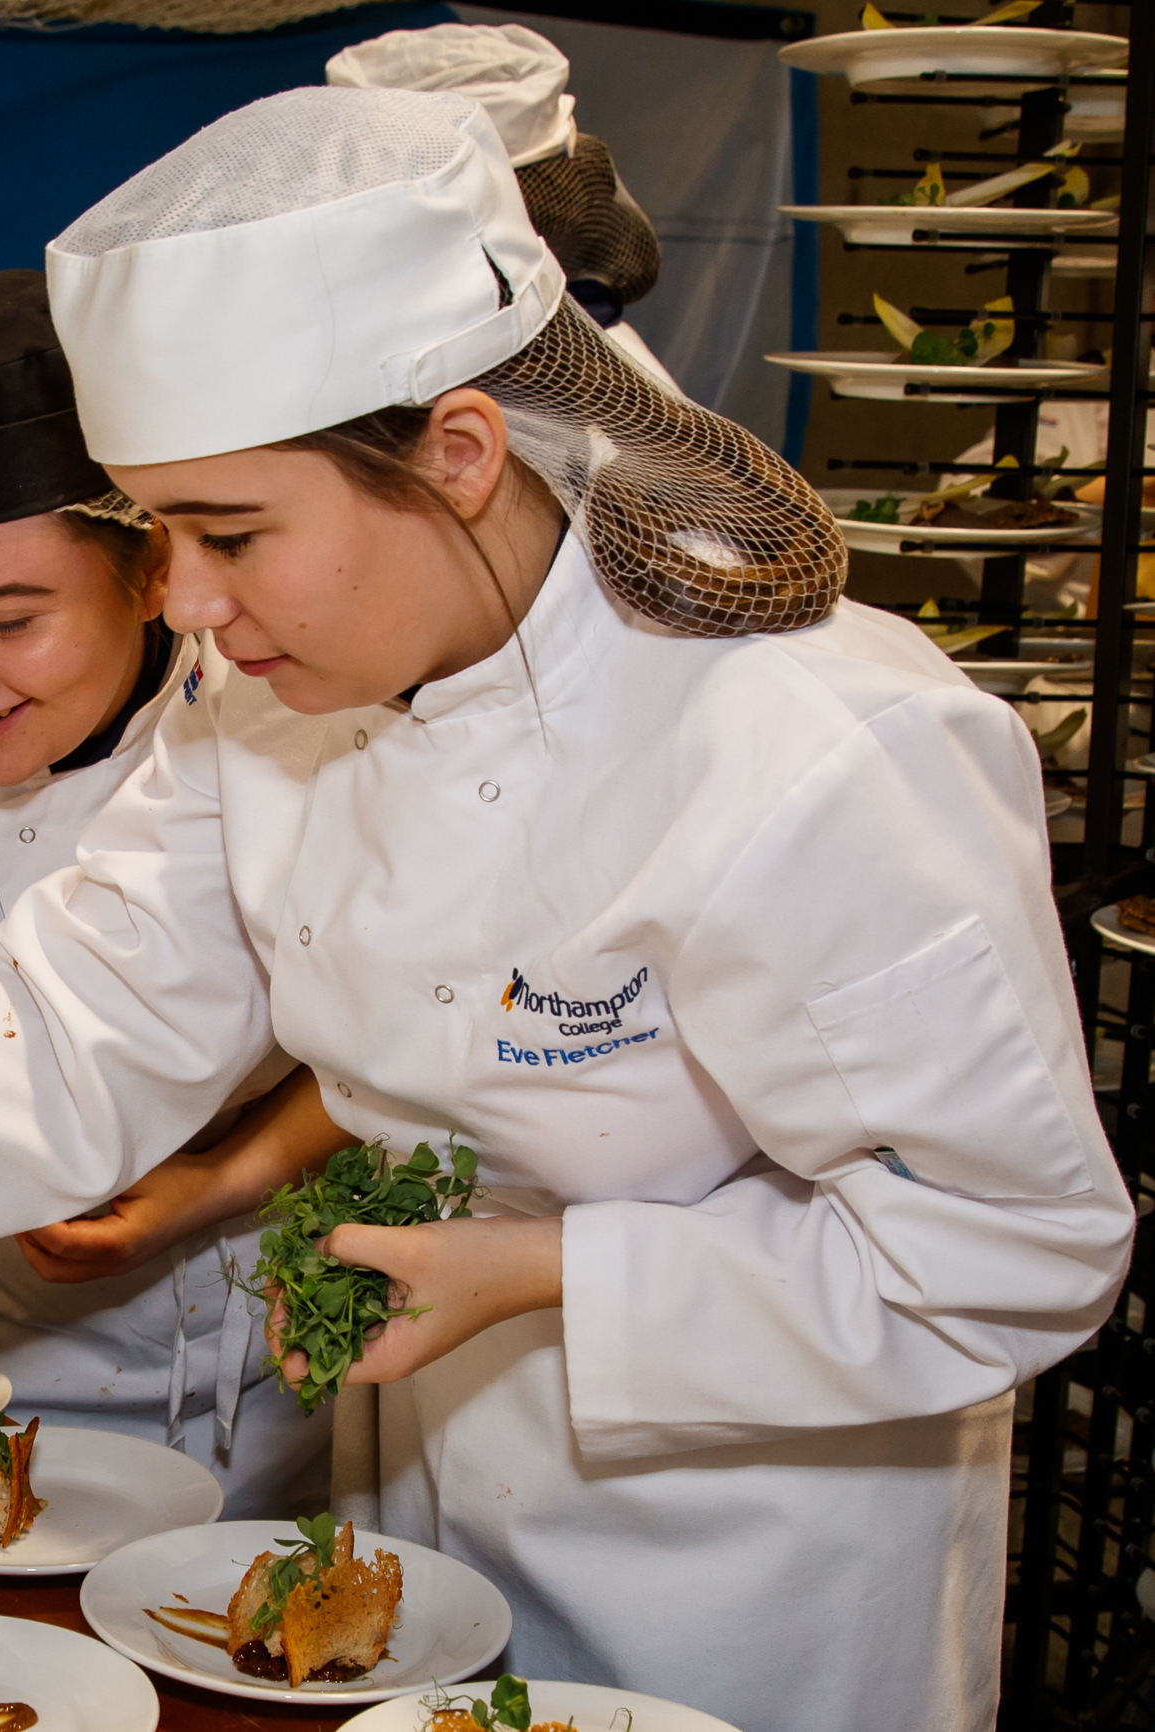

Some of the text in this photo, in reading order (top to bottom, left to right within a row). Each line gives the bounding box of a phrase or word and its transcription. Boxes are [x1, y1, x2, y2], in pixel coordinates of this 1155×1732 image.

[558, 1018, 623, 1036] College
[497, 1027, 660, 1067] Eve Fletcher
